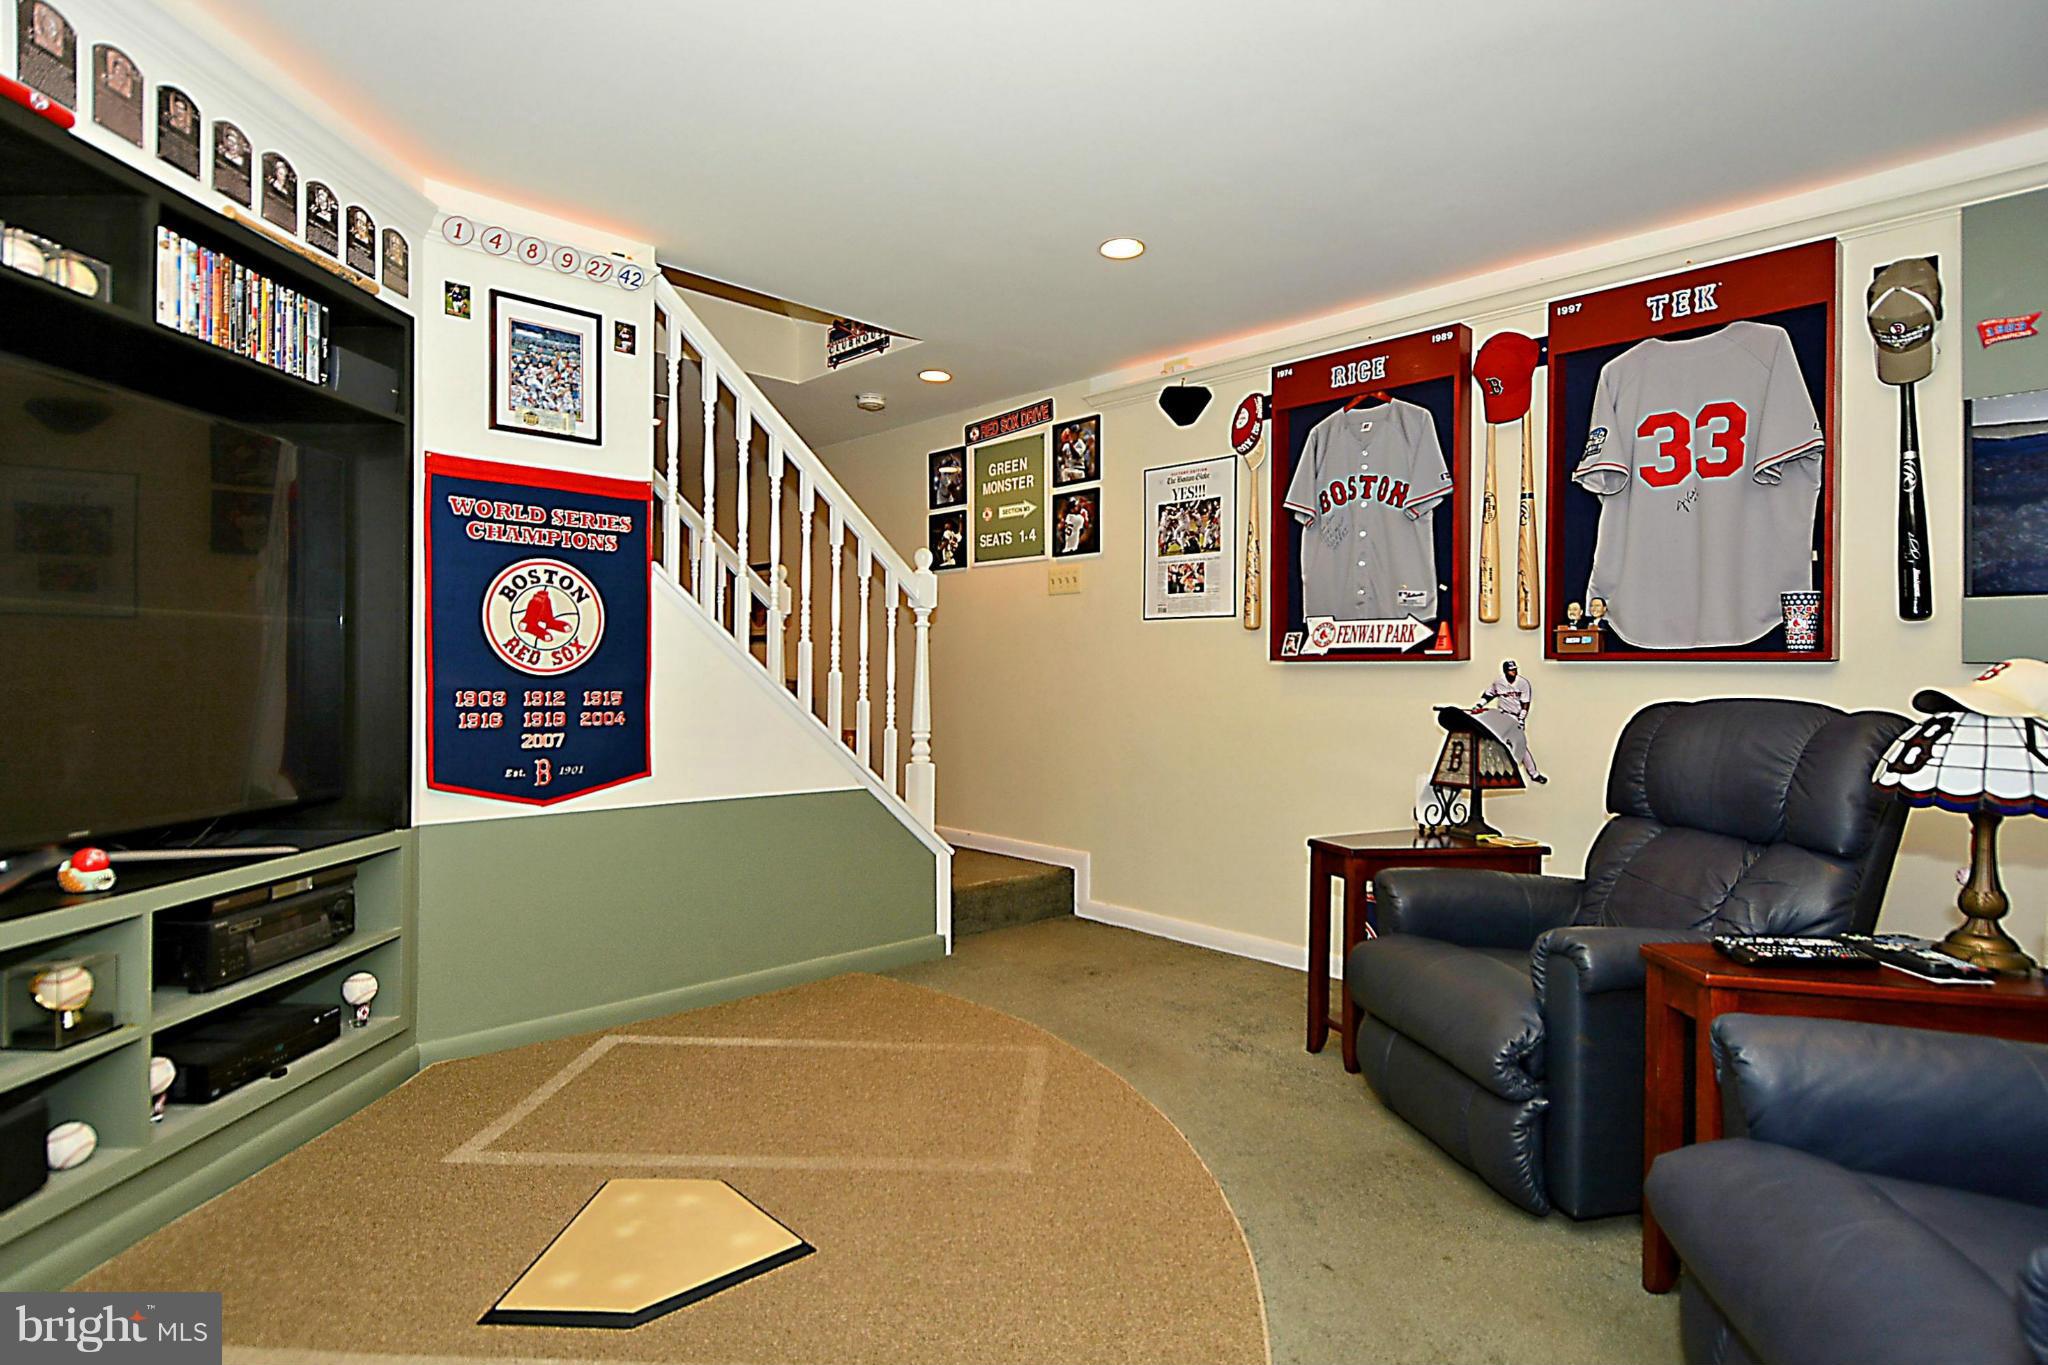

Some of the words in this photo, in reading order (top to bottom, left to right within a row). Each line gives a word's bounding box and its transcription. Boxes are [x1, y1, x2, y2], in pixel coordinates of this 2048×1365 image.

[454, 223, 463, 239] 1
[489, 232, 502, 249] 4
[526, 243, 538, 259] 8
[561, 253, 573, 268] 9
[587, 260, 613, 278] 27
[618, 269, 641, 287] 42
[1556, 303, 1582, 316] 1997
[1646, 282, 1718, 322] TEK
[1432, 332, 1453, 343] 1989
[1276, 369, 1293, 379] 1974
[1331, 356, 1386, 388] RICE
[981, 420, 999, 440] RED
[1000, 412, 1019, 433] SOX
[1020, 402, 1049, 427] DRIVE
[1636, 401, 1748, 489] 33
[988, 457, 1028, 476] GREEN
[982, 475, 1034, 495] MONSTER
[1172, 484, 1206, 501] YES!!!
[1319, 474, 1410, 515] BOSTON
[449, 495, 547, 523] WORLD
[551, 508, 633, 533] SERIES
[1002, 506, 1022, 515] SECTION
[465, 520, 619, 552] CHAMPIONS
[980, 531, 1013, 548] SEATS
[499, 569, 590, 604] BOSTON
[1336, 624, 1384, 643] FENWAY
[1384, 624, 1417, 643] PARK
[502, 636, 541, 666] RED
[551, 636, 587, 666] SOX
[455, 690, 508, 707] 1903
[523, 690, 566, 706] 1912
[583, 690, 623, 706] 1915
[523, 711, 567, 727] 1918
[579, 711, 626, 726] 2004
[520, 732, 565, 749] 2007
[1448, 740, 1465, 772] B
[504, 768, 527, 778] Est.
[533, 758, 552, 787] B
[558, 765, 584, 776] 1901
